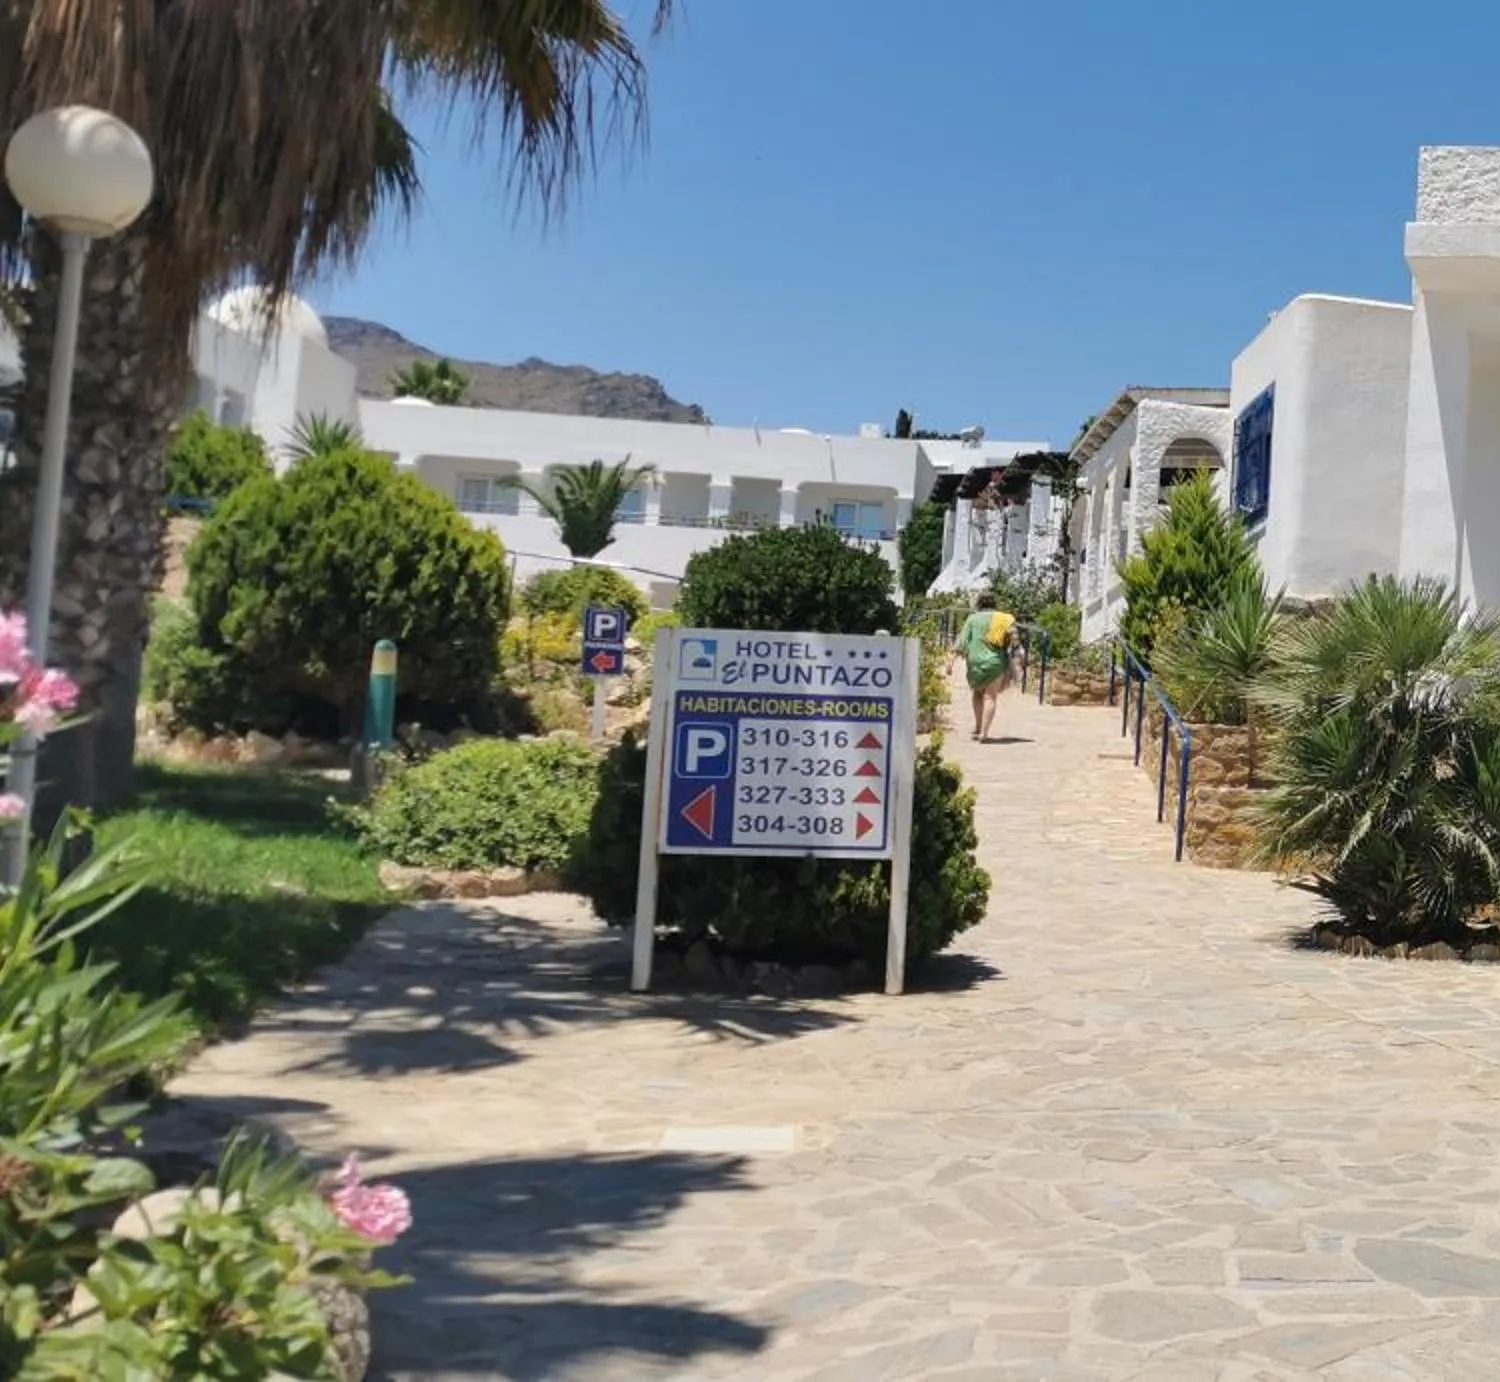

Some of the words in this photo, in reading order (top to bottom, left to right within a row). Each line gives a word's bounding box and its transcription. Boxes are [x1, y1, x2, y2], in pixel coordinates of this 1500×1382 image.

[594, 614, 617, 637] P
[735, 641, 817, 660] HOTEL
[722, 661, 745, 684] El
[751, 663, 892, 688] PUNTAZO
[680, 696, 889, 719] HABITACIONES-ROOMS
[742, 727, 849, 748] 310-316
[685, 729, 726, 773] P
[741, 757, 847, 777] 317-326
[739, 785, 845, 806] 327-333
[737, 815, 843, 835] 304-308
